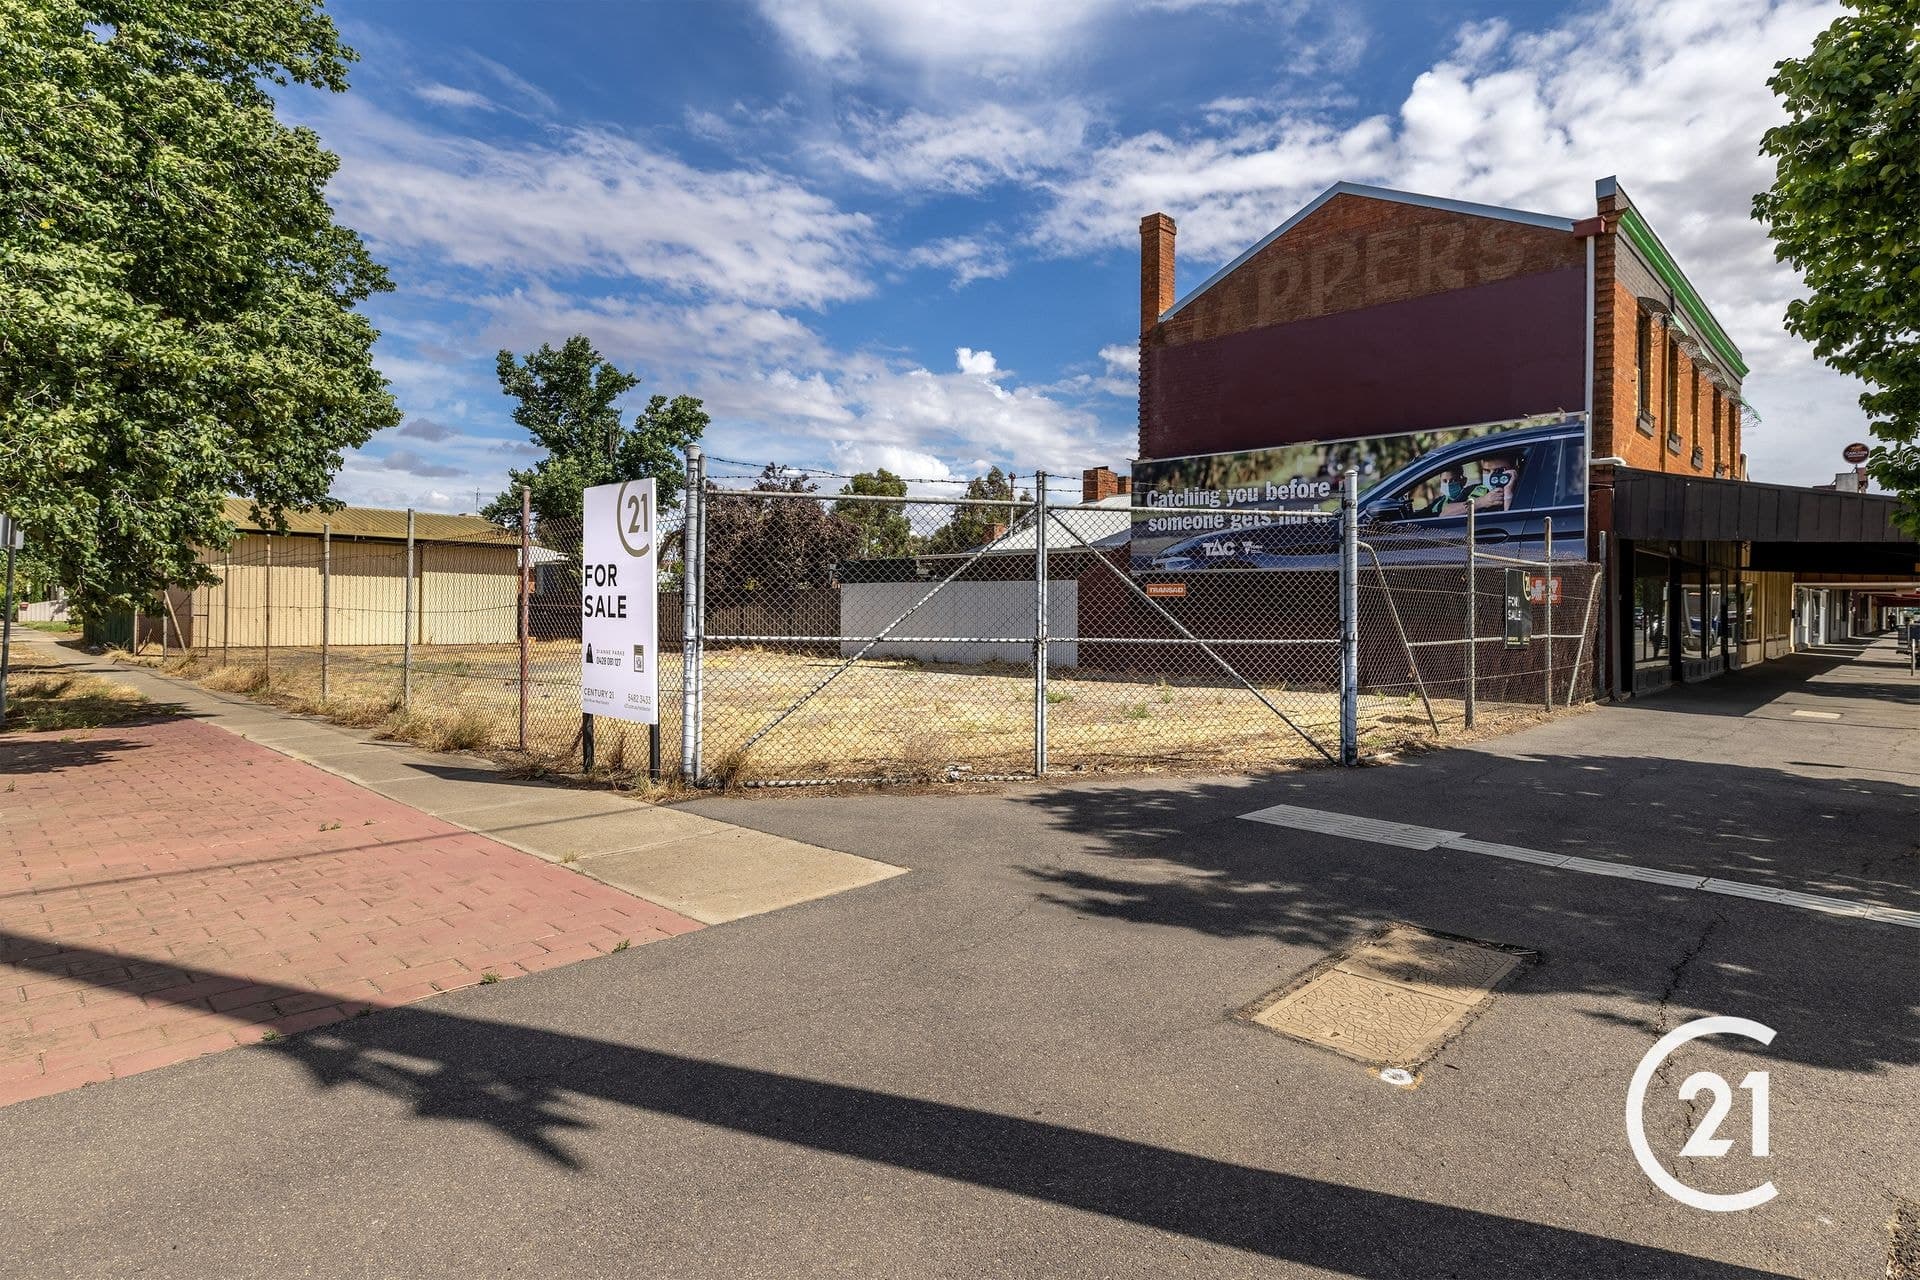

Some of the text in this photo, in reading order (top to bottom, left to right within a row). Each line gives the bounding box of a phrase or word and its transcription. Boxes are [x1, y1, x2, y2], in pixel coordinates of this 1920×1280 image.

[1146, 479, 1331, 508] Catching you before
[627, 493, 648, 534] 21
[1148, 513, 1225, 532] someone
[1230, 508, 1272, 531] gets
[1202, 539, 1236, 556] TAC
[584, 564, 617, 587] FOR
[584, 595, 627, 619] SALE
[583, 687, 608, 698] CENTURY
